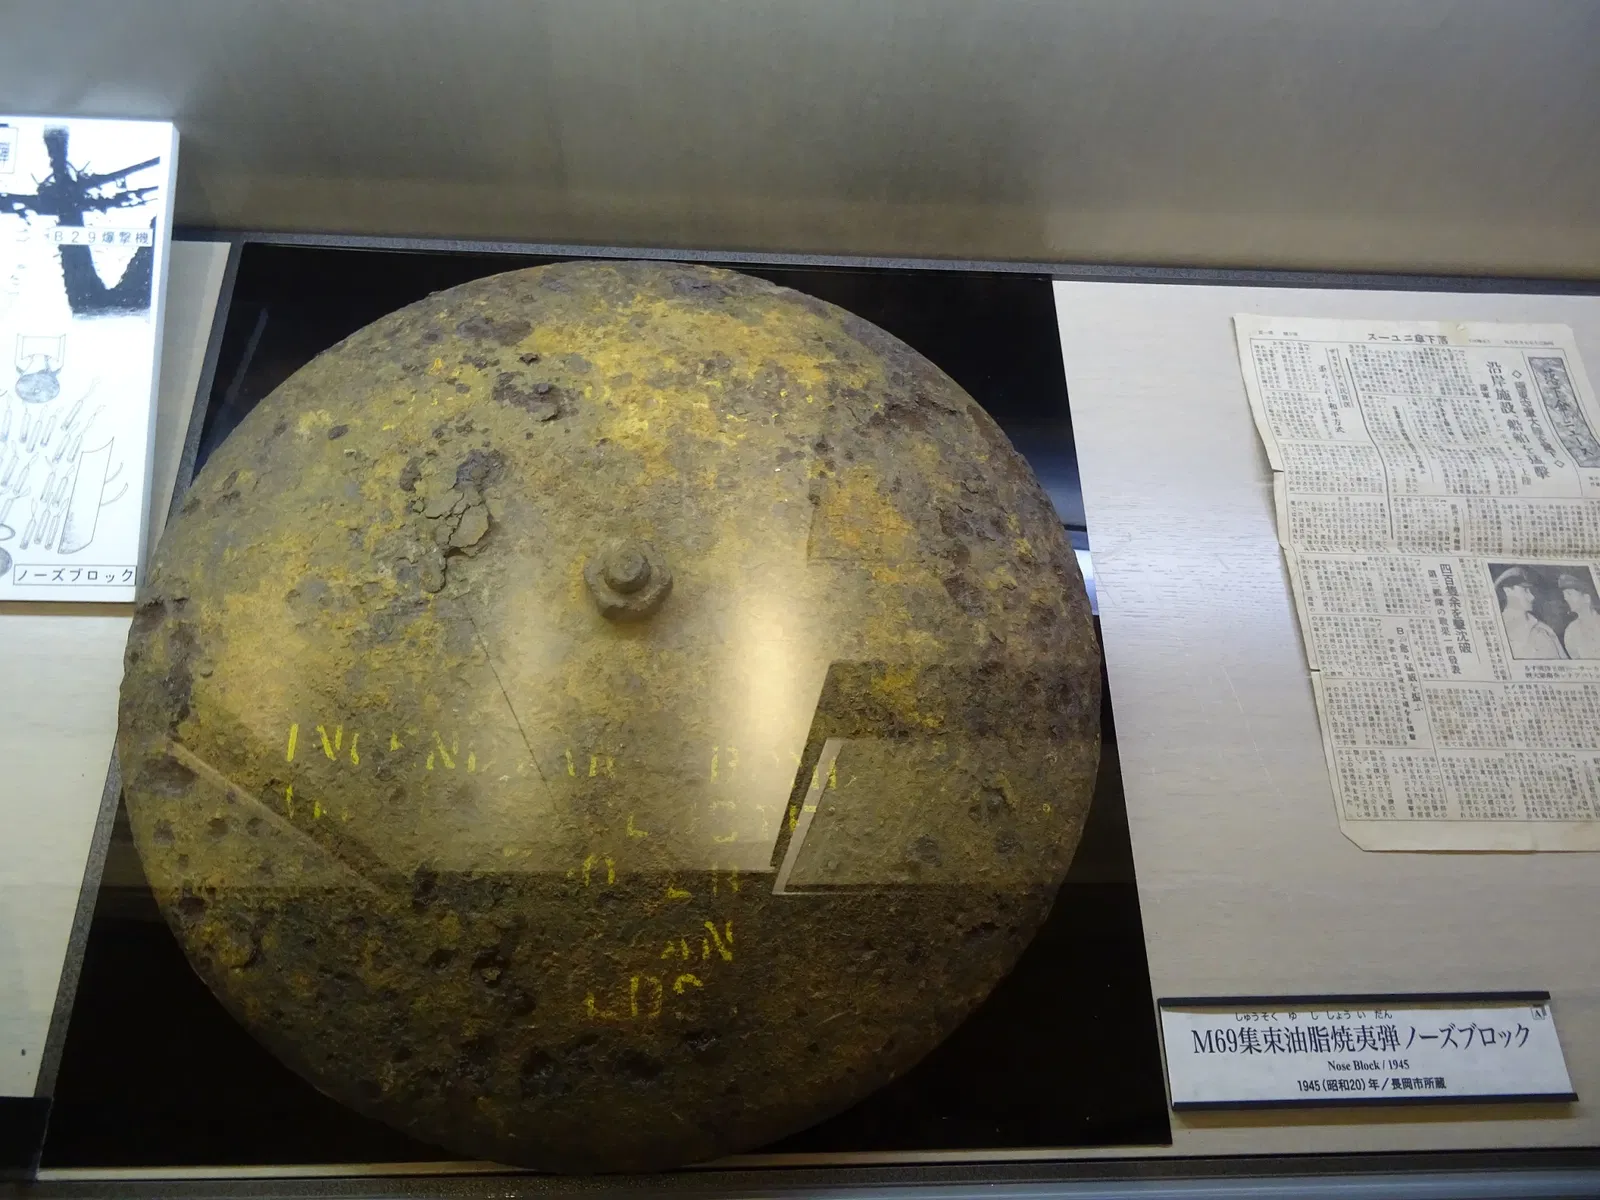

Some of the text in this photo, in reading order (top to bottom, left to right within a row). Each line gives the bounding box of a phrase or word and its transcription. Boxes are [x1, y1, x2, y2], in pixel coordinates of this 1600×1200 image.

[17, 567, 134, 583] ノーズブロック
[1288, 1011, 1298, 1021] ゆ
[1310, 1011, 1319, 1021] し
[1326, 1010, 1351, 1020] しょう
[1357, 1011, 1366, 1019] い
[1374, 1010, 1393, 1019] だん
[1327, 1060, 1351, 1072] Nose
